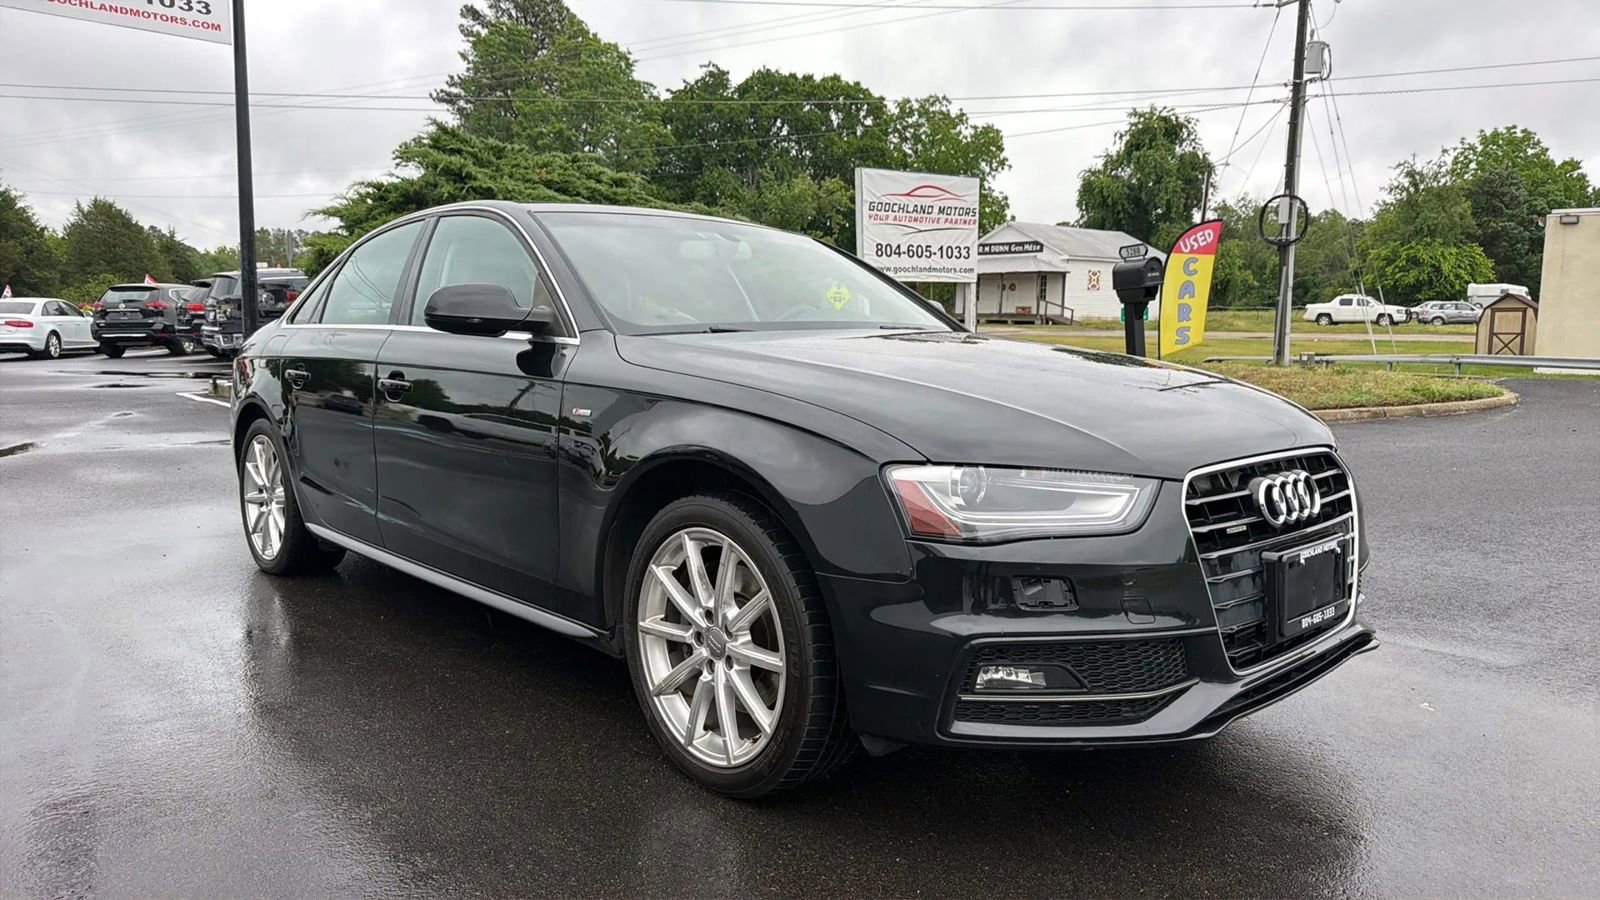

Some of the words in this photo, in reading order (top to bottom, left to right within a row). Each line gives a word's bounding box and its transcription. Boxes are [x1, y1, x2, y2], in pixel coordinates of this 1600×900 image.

[868, 201, 934, 215] GOOCHLAND
[937, 206, 977, 217] MOTORS
[868, 213, 890, 221] YOUR
[892, 215, 942, 225] AUTOMOTIVE
[944, 218, 977, 226] PARTNER
[1180, 229, 1214, 252] USED
[875, 242, 971, 260] 804-605-1033
[1175, 257, 1199, 345] CARS
